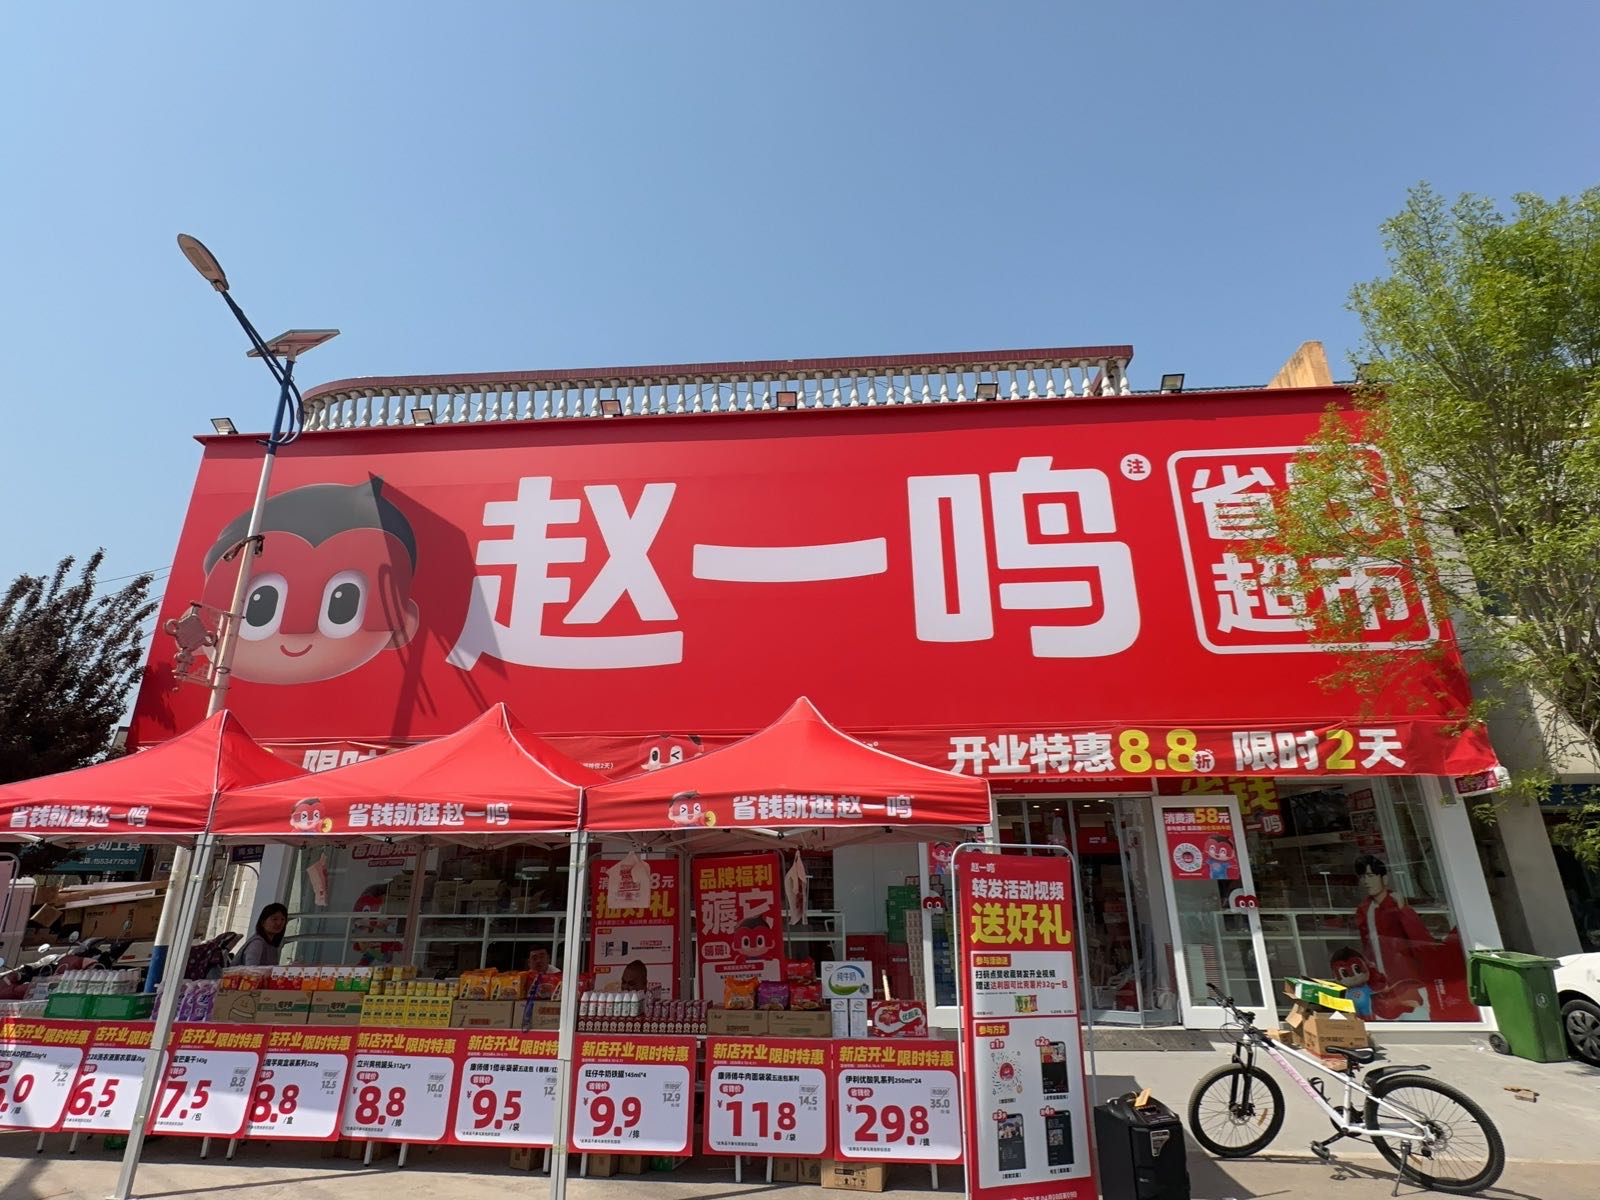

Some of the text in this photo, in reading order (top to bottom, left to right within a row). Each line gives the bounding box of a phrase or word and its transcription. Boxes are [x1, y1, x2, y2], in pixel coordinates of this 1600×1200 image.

[1126, 458, 1146, 475] 注
[445, 456, 1141, 670] 赵一鸣
[1211, 553, 1410, 633] 超市
[1232, 728, 1406, 773] 限时2天
[10, 805, 149, 829] 省钱就逛赵一鸣
[348, 801, 511, 828] 省钱就逛赵一鸣
[732, 795, 914, 820] 省钱就逛赵一鸣
[1164, 808, 1230, 825] 消费满58元
[700, 863, 773, 890] 品牌福利
[970, 862, 996, 873] 赵一鸣
[971, 877, 1065, 900] 转发活动视频
[970, 902, 1072, 945] 送好礼
[42, 1028, 91, 1045] 限时特惠
[180, 1028, 265, 1050] 店开业 限时特惠
[978, 1024, 1007, 1035] 参与方式
[300, 1035, 352, 1051] 限时特惠
[357, 1032, 457, 1054] 新店开业 限时特惠
[467, 1034, 521, 1052] 新店开业
[581, 1041, 690, 1062] 新店开业 限时特惠
[713, 1043, 825, 1065] 新店开业 限时特惠
[840, 1046, 954, 1067] 新店开业 限时特惠
[230, 1076, 247, 1089] 8.8
[321, 1079, 337, 1090] 12.5
[426, 1083, 444, 1094] 10.0
[68, 1078, 120, 1116] 6.5
[160, 1080, 212, 1120] 7.5
[250, 1083, 300, 1123] 8.8
[355, 1085, 406, 1126] 8.8
[662, 1092, 681, 1103] 12.9
[799, 1095, 818, 1106] 14.5
[929, 1098, 950, 1109] 35.0
[472, 1089, 522, 1130] 9.5
[589, 1096, 642, 1137] 9.9
[726, 1101, 797, 1141] 11.8
[854, 1104, 930, 1145] 29.8
